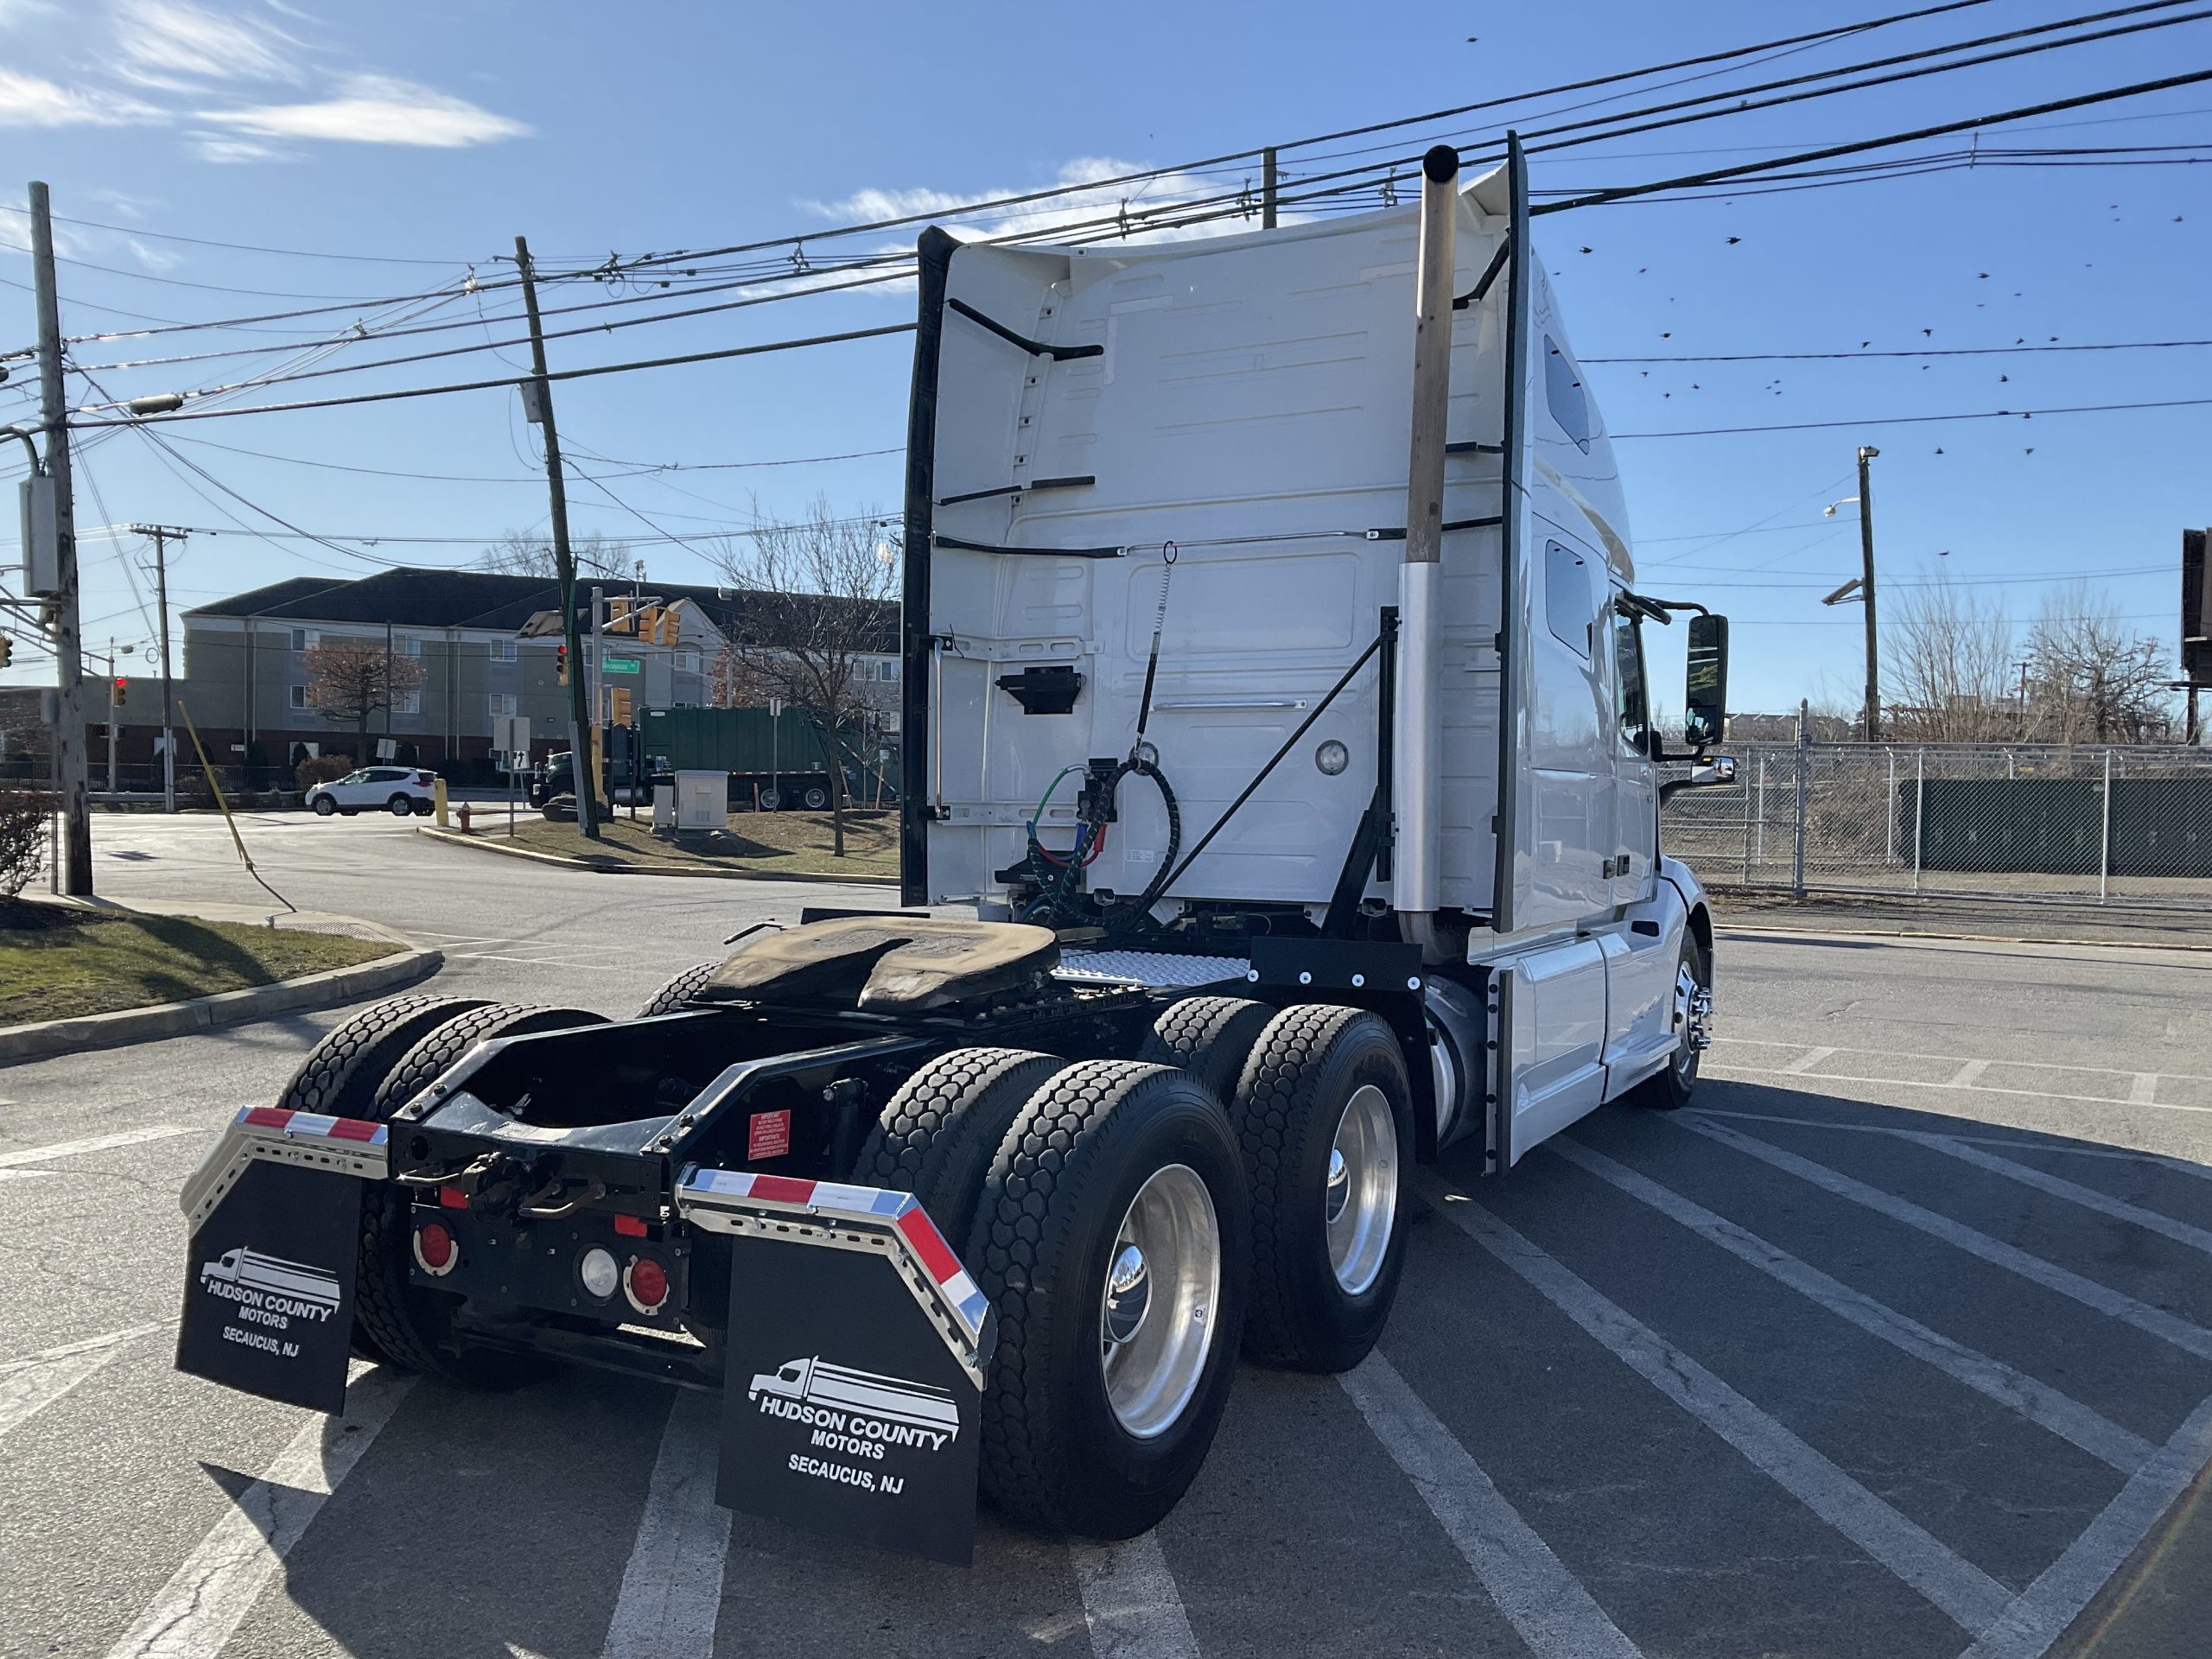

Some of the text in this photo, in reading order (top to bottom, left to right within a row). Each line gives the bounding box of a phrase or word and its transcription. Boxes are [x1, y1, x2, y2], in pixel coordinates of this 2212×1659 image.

[207, 1281, 332, 1322] HUDSON COUNTY
[238, 1306, 289, 1330] MOTORS
[222, 1325, 300, 1357] SECAUCUS, NJ
[760, 1395, 948, 1452] HUDSON COUNTY
[810, 1429, 886, 1460] MOTORS
[788, 1453, 905, 1495] SECAUCUS, NJ
